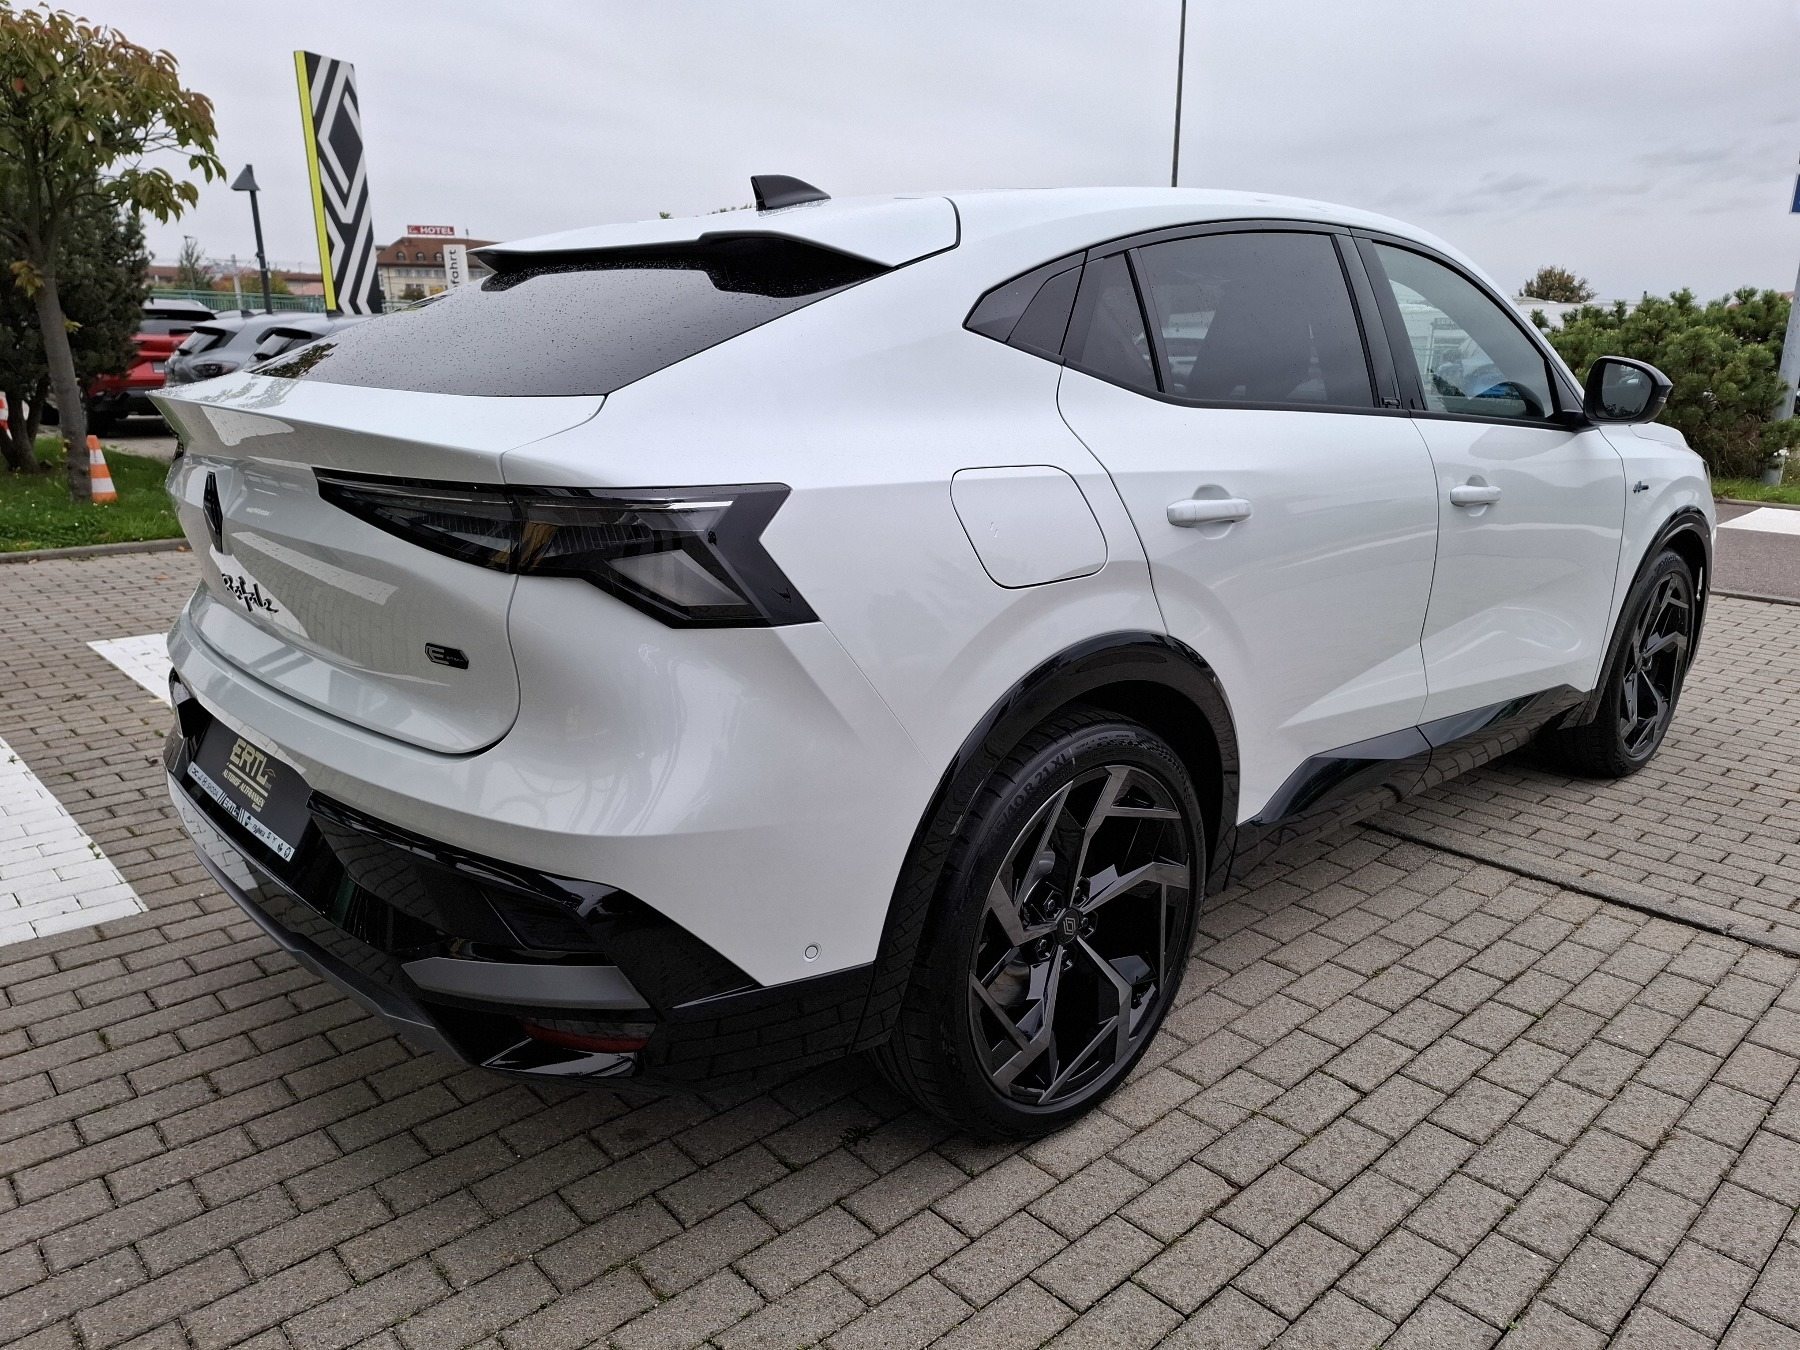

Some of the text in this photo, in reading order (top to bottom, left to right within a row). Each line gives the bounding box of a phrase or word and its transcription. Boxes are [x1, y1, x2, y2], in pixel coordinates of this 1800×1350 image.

[420, 226, 454, 235] HOTEL
[229, 738, 268, 786] ERTL
[222, 797, 238, 815] ERTL
